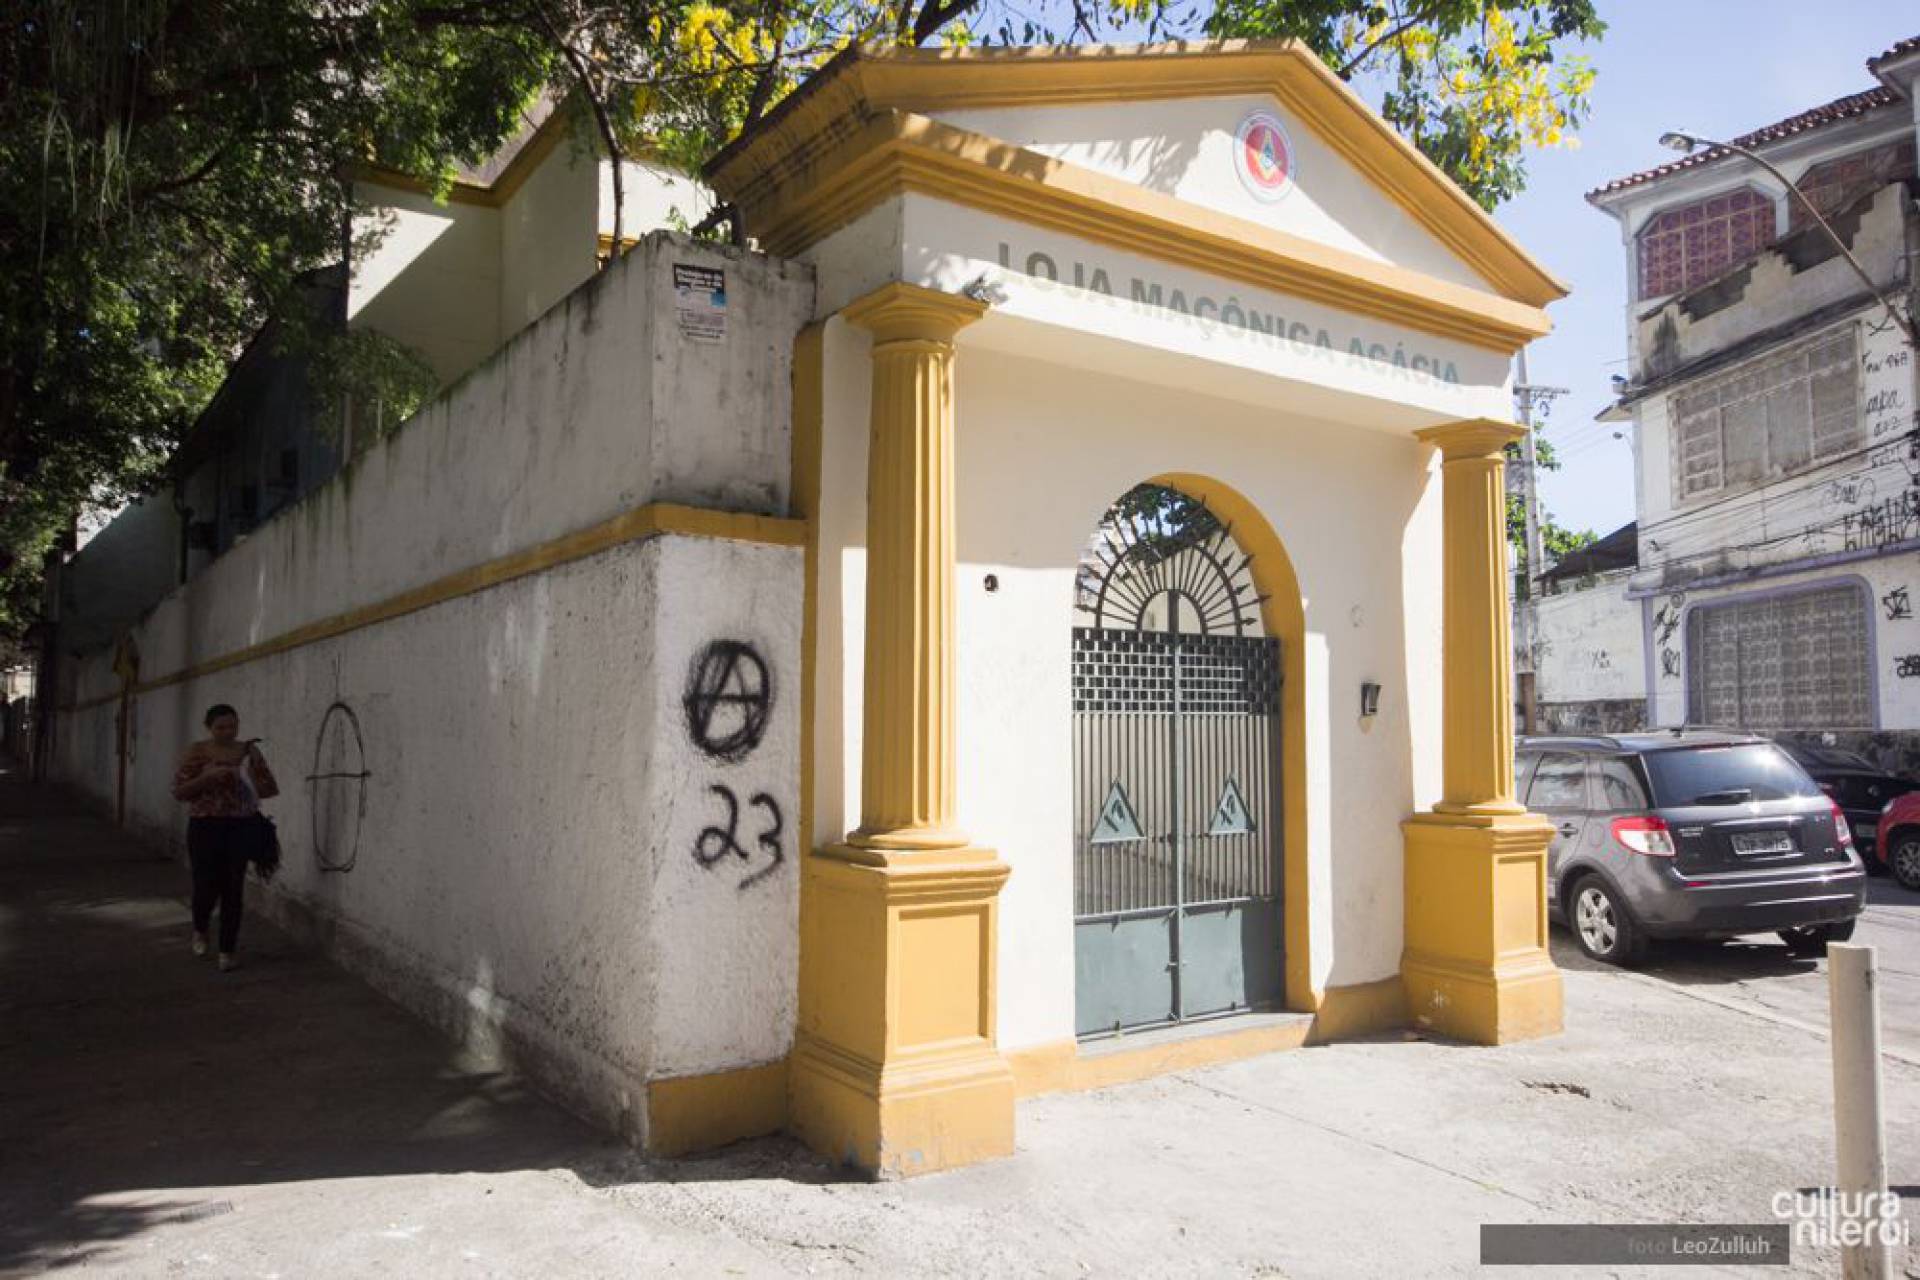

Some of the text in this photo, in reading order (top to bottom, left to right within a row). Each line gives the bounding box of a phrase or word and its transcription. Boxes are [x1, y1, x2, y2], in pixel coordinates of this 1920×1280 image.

[998, 241, 1116, 306] LOJA
[1347, 337, 1461, 394] ACÁCIA
[692, 784, 784, 890] 23
